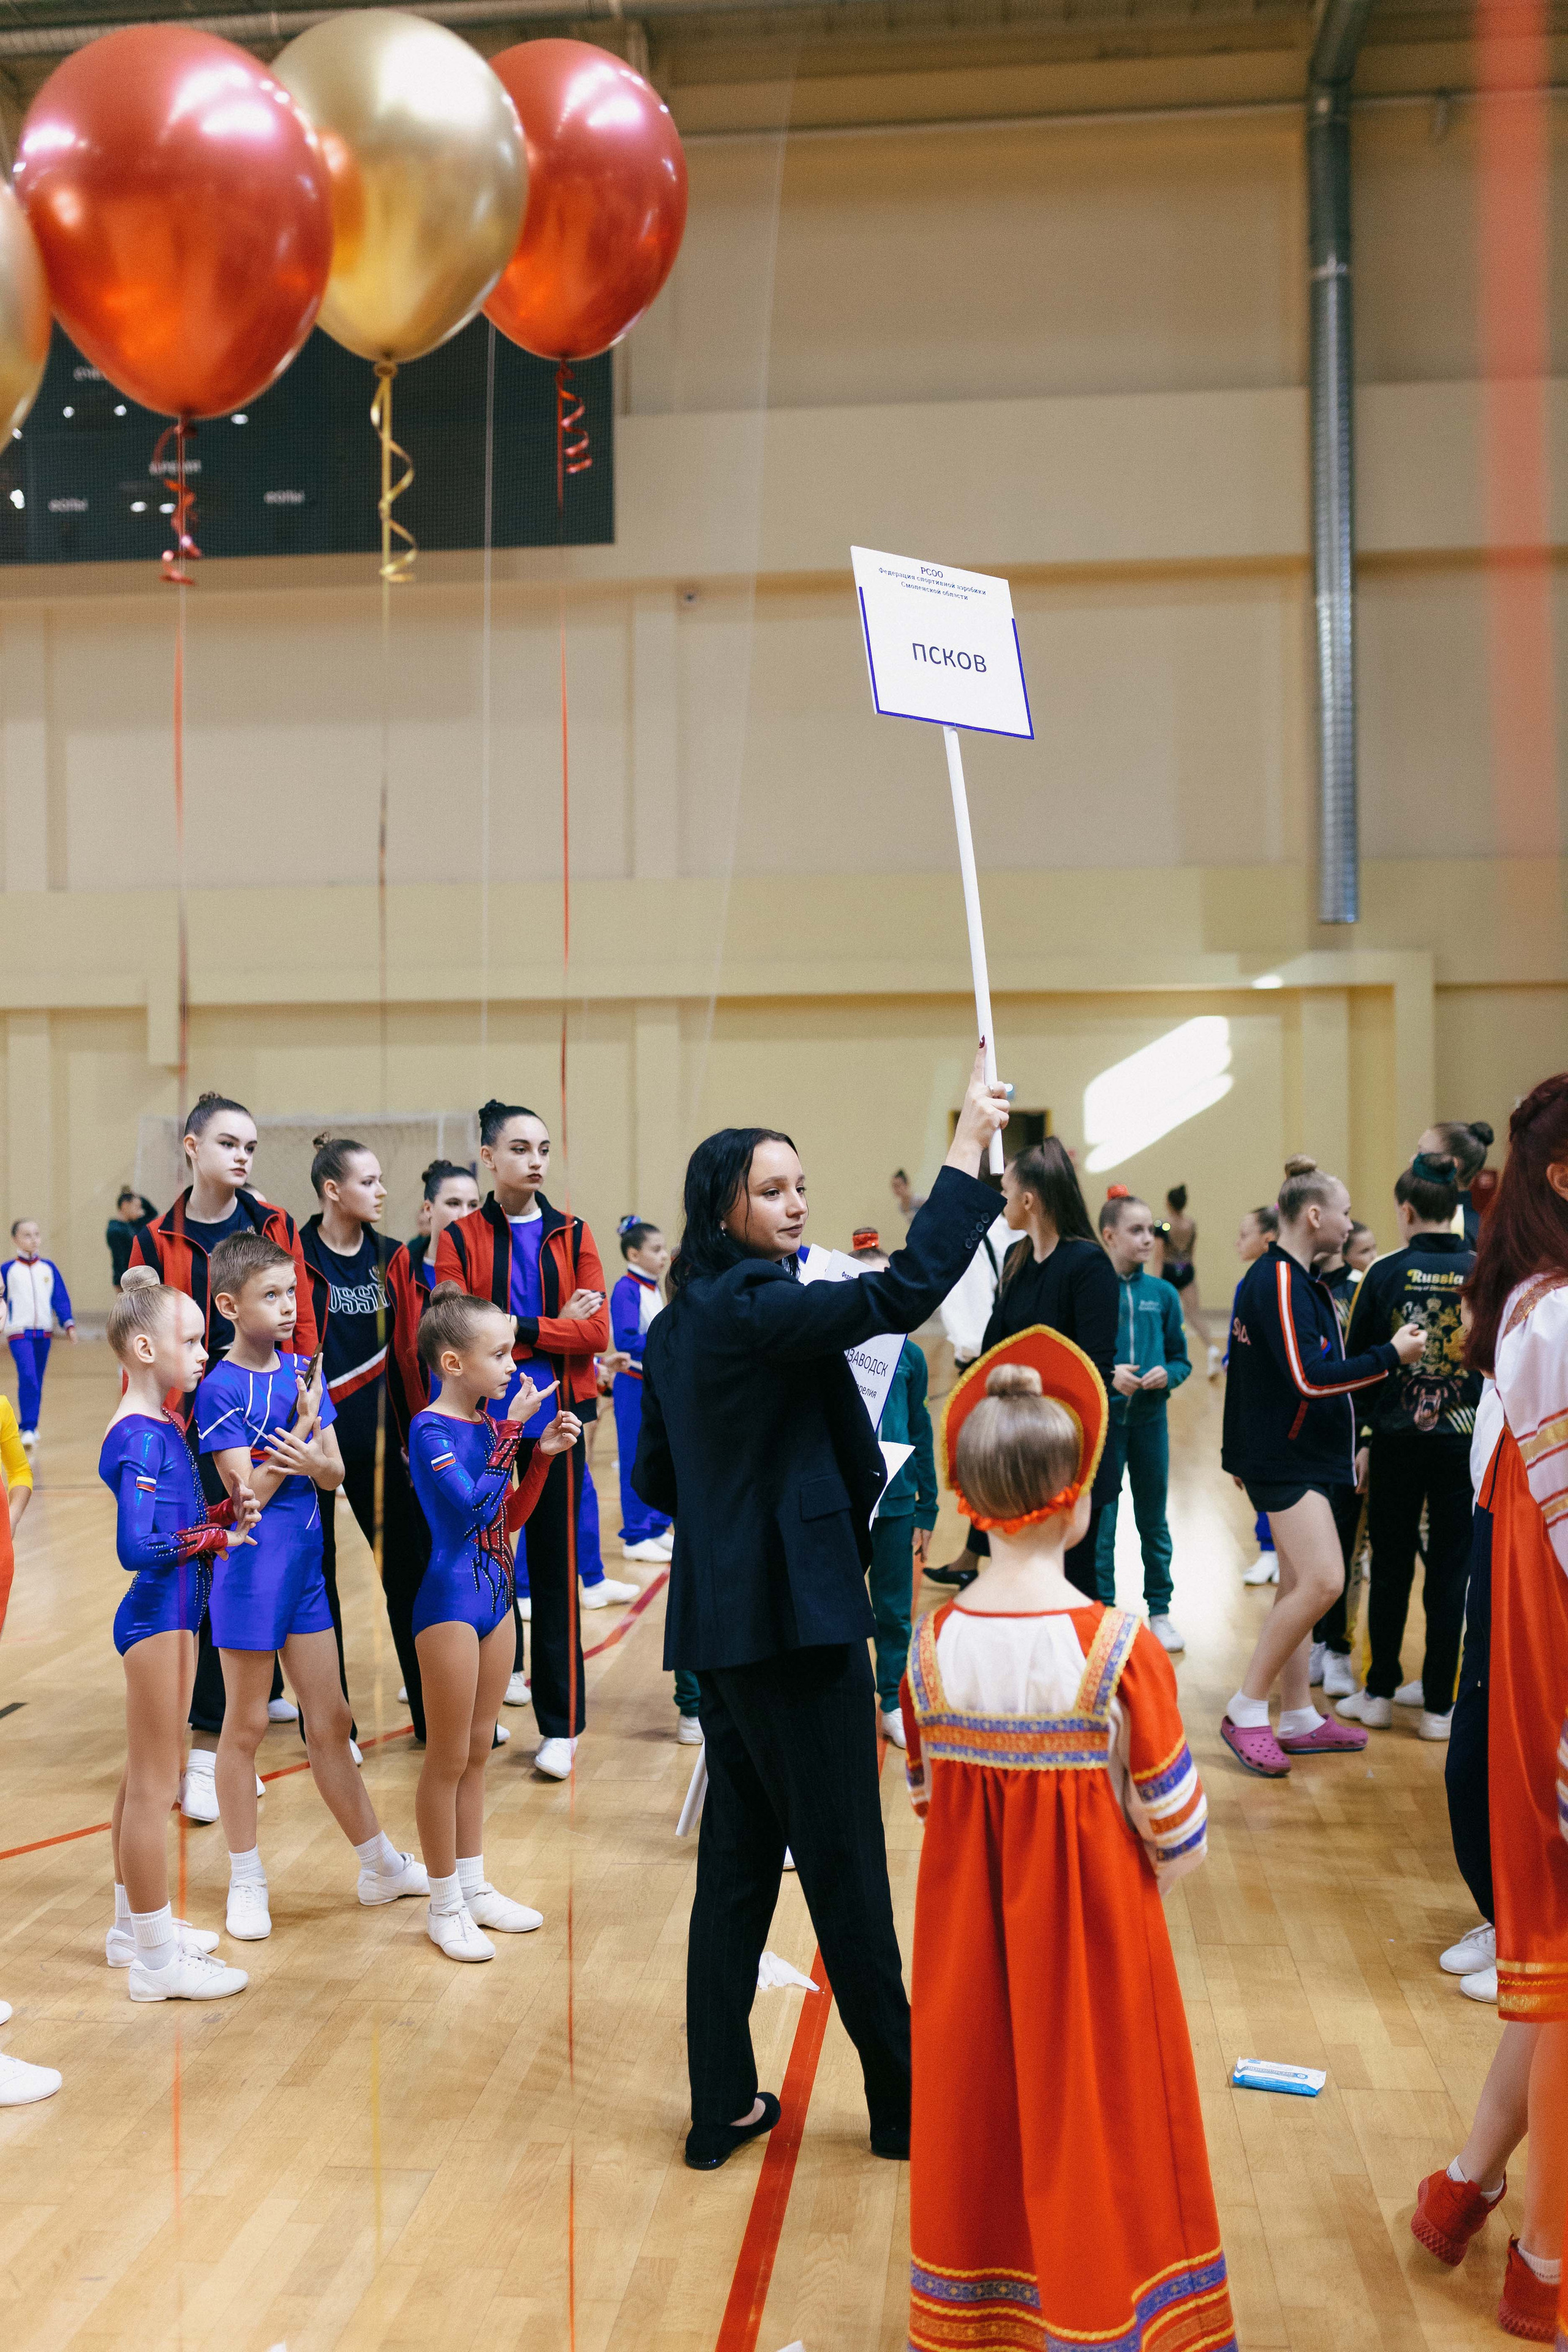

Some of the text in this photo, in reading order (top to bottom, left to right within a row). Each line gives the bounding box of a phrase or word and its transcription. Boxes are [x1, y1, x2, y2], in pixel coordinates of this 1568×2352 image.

[878, 567, 986, 595] Федерация спортивной аэробики
[920, 567, 943, 578] РСОО
[901, 581, 968, 600] Смоленской области
[912, 643, 987, 673] ПСКОВ
[1407, 1268, 1464, 1285] Russia
[328, 1283, 391, 1314] USSI
[846, 1348, 889, 1377] ЗАВОДСК
[856, 1384, 877, 1399] релия
